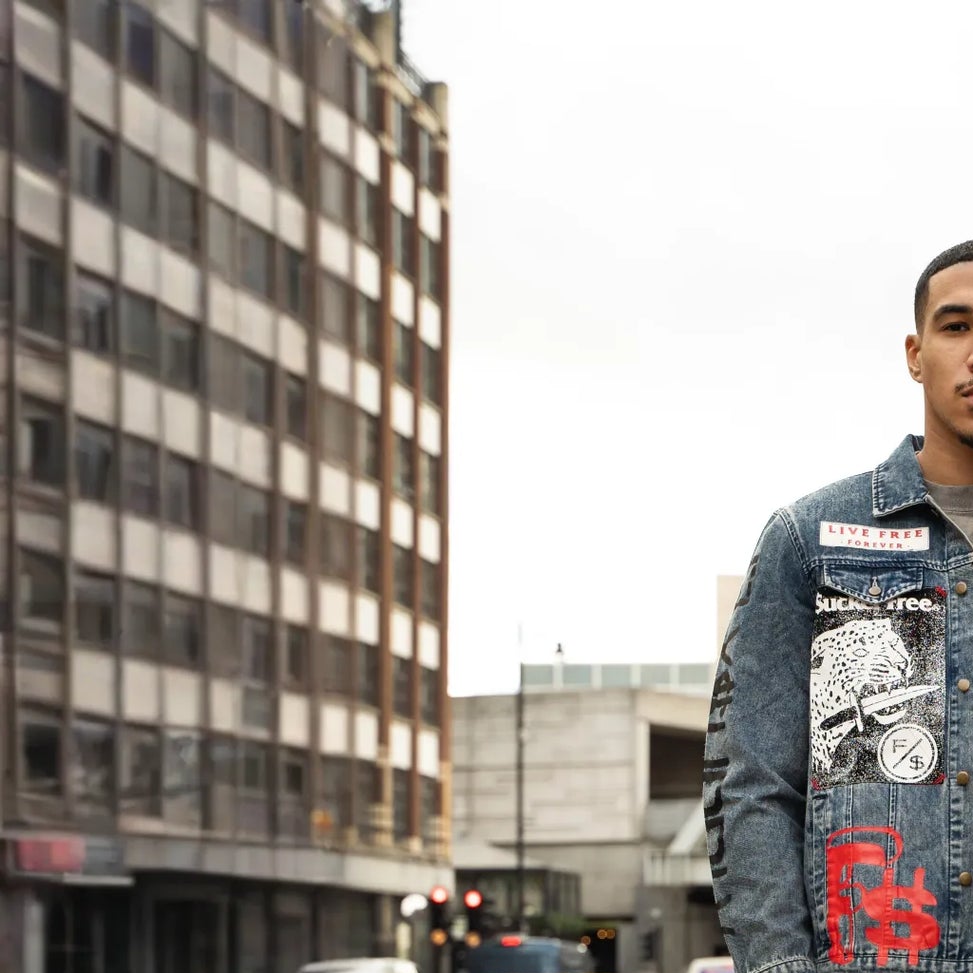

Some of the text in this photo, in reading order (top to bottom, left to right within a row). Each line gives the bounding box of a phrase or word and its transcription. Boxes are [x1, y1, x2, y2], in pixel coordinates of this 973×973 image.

[829, 525, 922, 539] LIVE FREE
[848, 539, 902, 549] FOREVER
